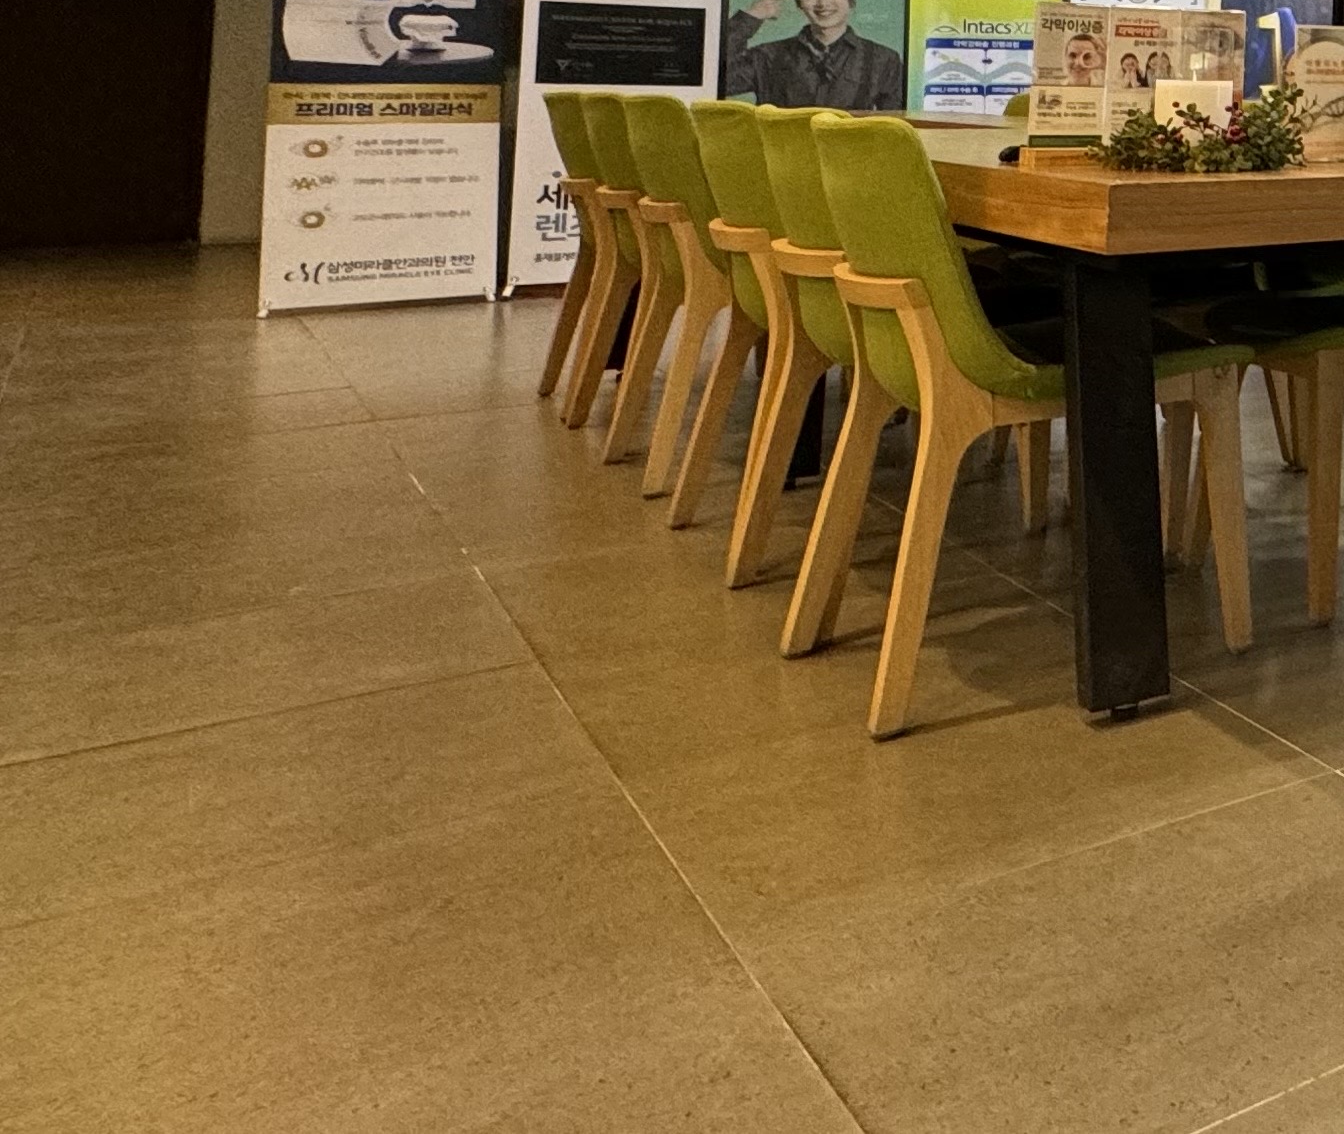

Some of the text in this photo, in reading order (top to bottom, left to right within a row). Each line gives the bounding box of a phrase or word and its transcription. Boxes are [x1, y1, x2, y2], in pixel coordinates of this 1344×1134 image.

[963, 18, 1011, 35] Intacs
[295, 102, 473, 117] 프리미엄 스마일라식
[536, 183, 576, 211] 세
